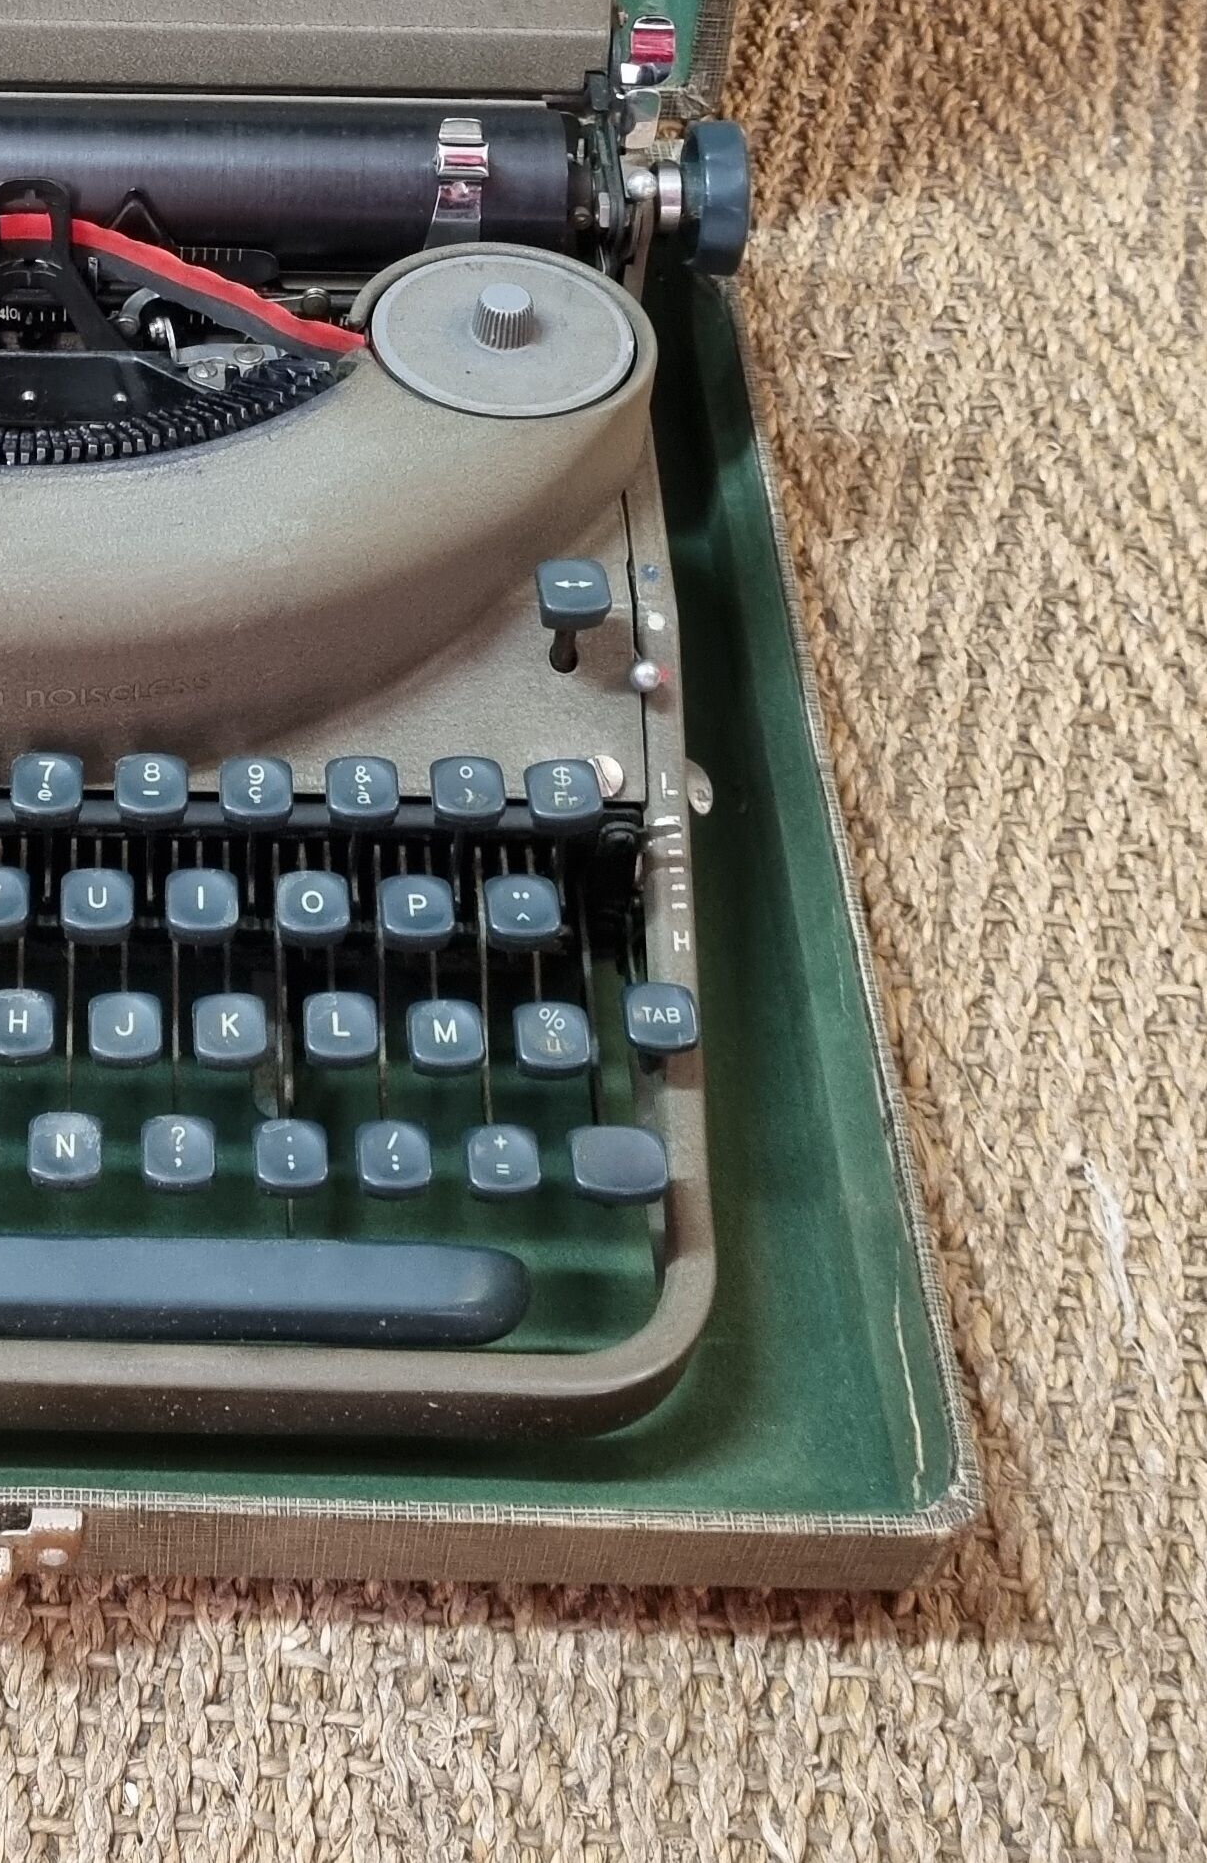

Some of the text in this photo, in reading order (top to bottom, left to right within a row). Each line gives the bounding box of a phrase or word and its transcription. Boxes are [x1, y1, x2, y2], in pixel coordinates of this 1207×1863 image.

[38, 760, 57, 782] 7
[143, 762, 161, 783] 8
[247, 764, 266, 786] 9
[354, 765, 372, 784] &
[551, 766, 572, 787] $
[88, 886, 108, 909] U
[407, 893, 428, 917] P
[7, 1009, 28, 1034] H
[114, 1011, 134, 1036] J
[221, 1012, 240, 1038] K
[331, 1011, 351, 1037] L
[433, 1019, 458, 1044] M
[642, 1006, 681, 1025] TAB
[55, 1133, 76, 1158] N
[171, 1126, 185, 1152] ?
